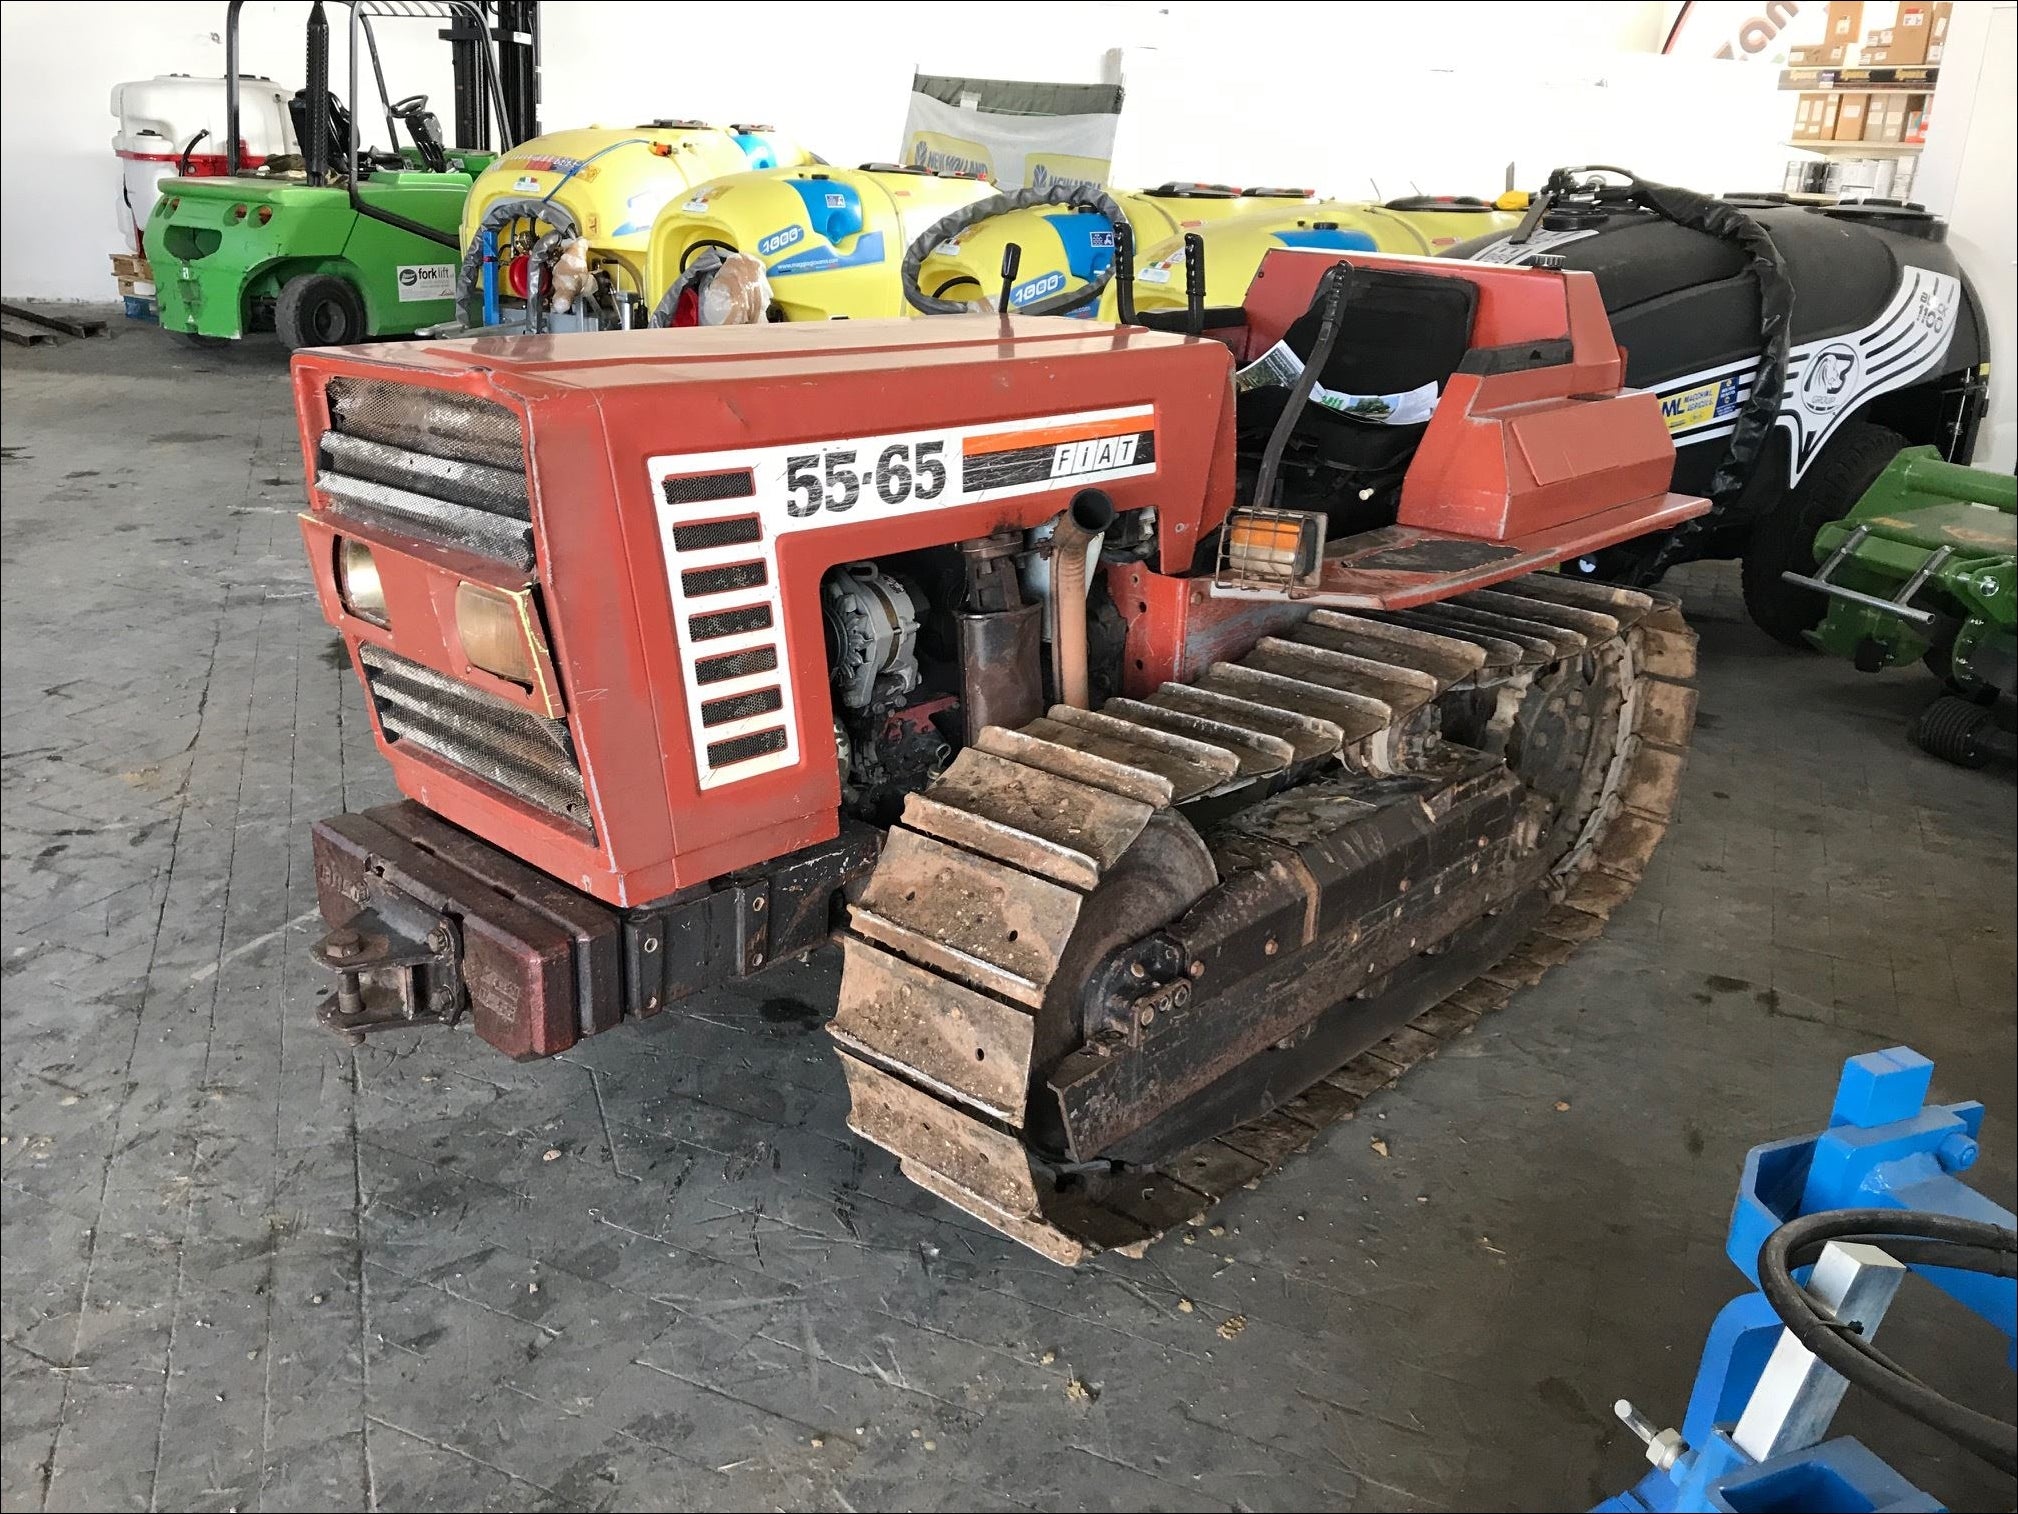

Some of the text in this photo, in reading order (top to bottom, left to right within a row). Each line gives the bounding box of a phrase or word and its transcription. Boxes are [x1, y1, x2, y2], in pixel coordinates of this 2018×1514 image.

[418, 267, 437, 280] fork
[1014, 274, 1060, 303] 1000
[1916, 304, 1943, 334] 1100
[1057, 439, 1134, 471] FIAT
